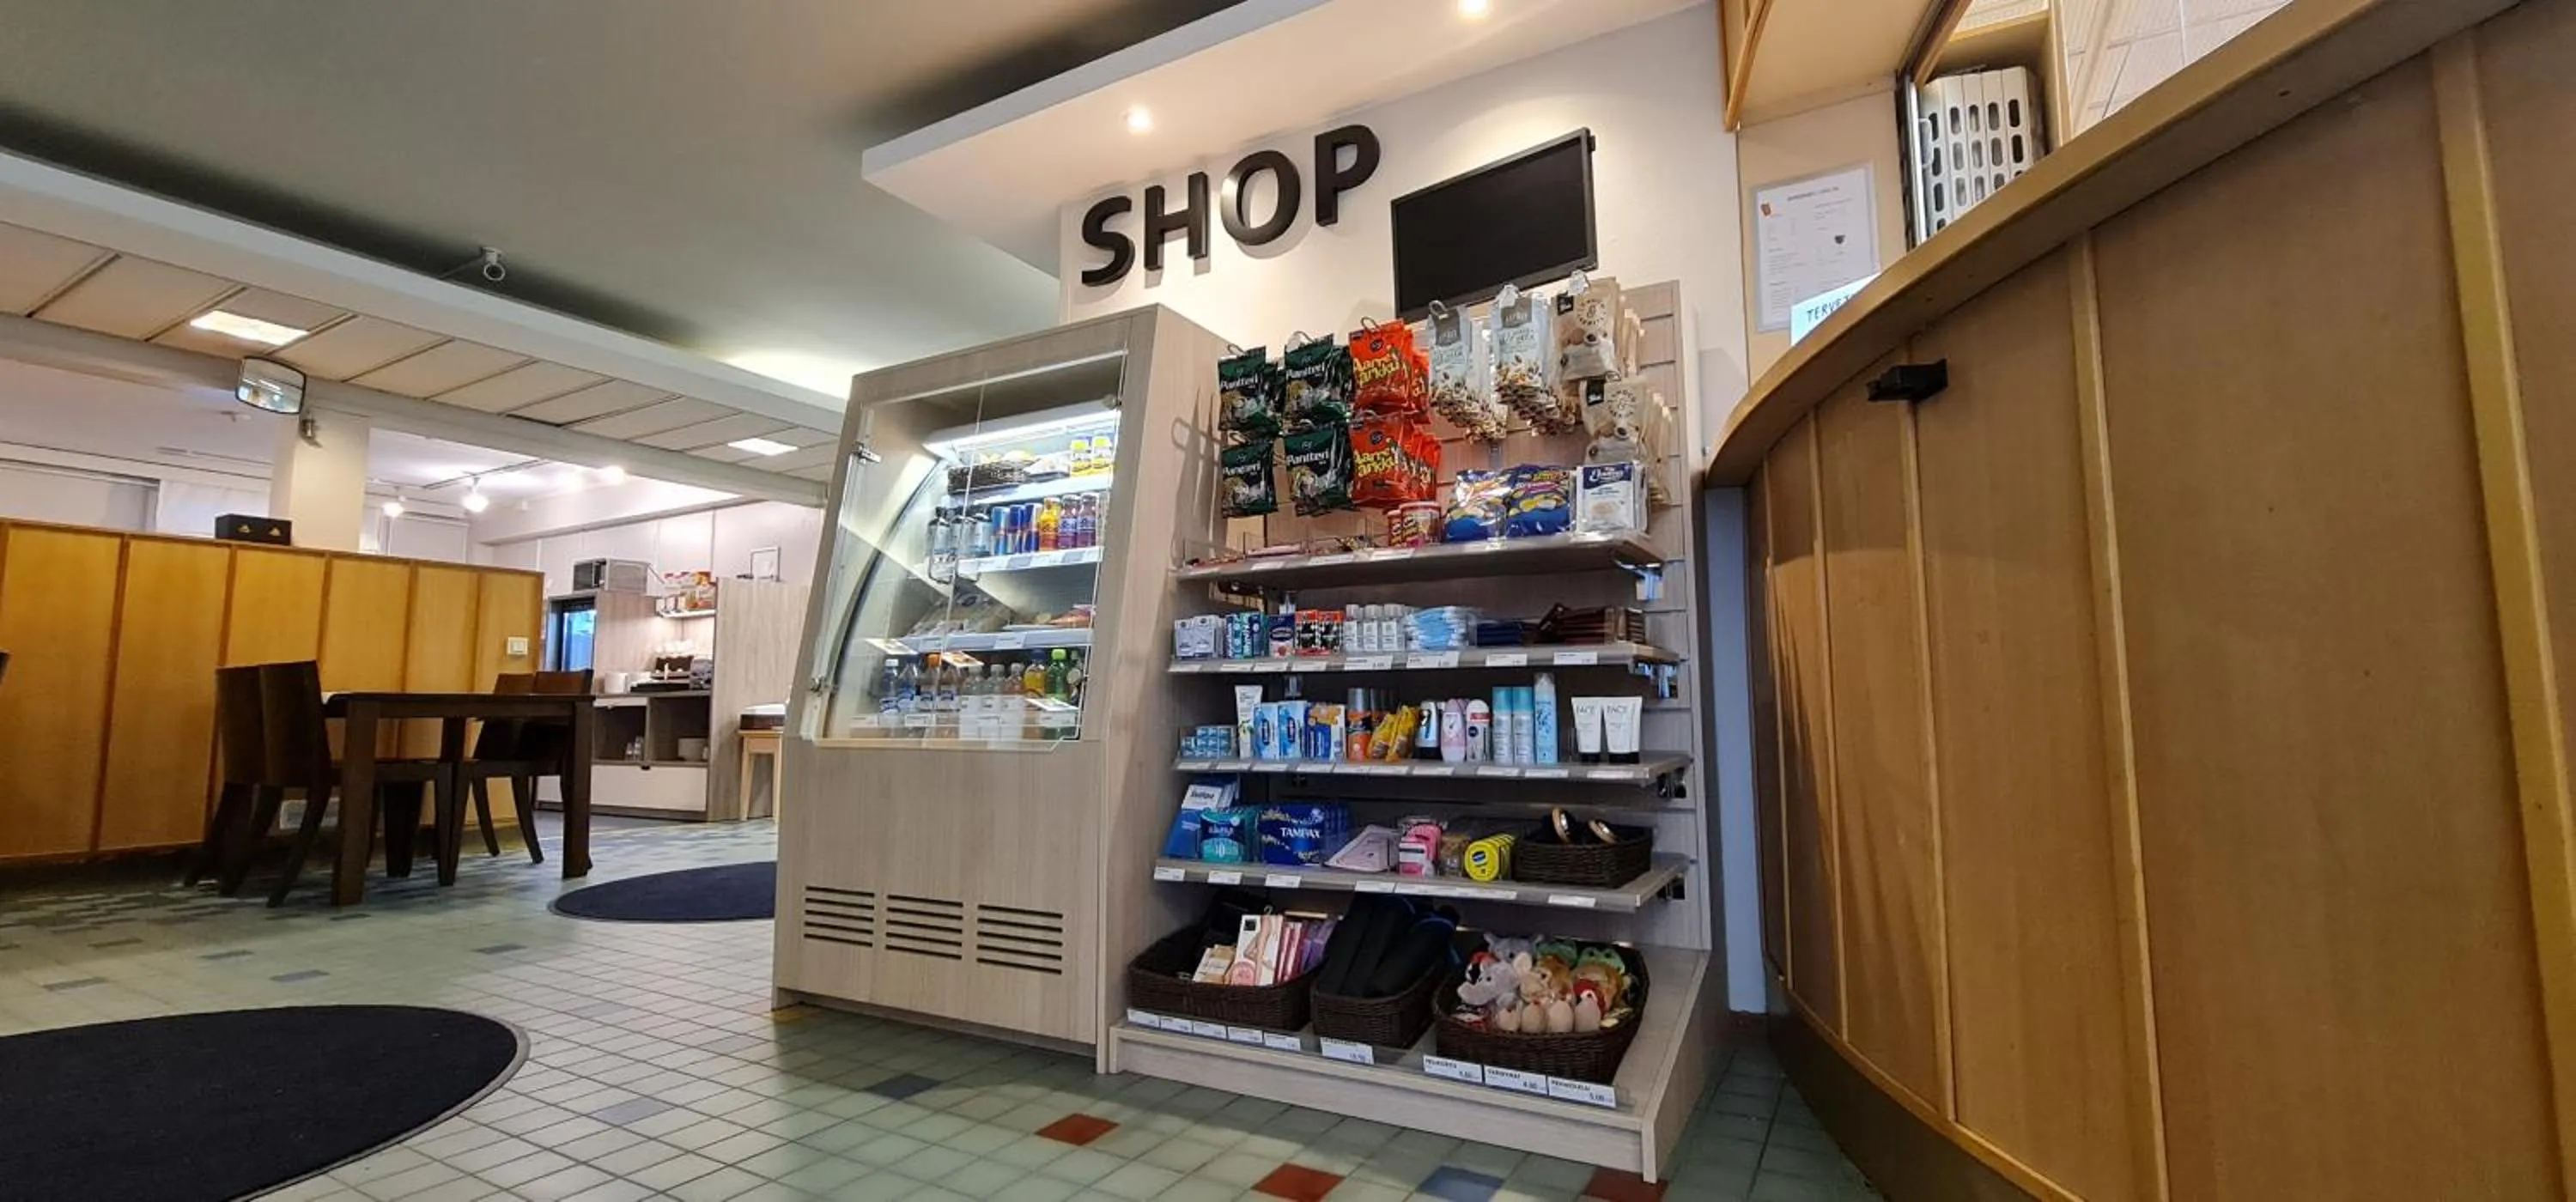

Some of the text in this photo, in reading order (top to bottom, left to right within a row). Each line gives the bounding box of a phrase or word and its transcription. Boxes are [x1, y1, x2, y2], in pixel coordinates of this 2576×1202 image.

[1081, 124, 1381, 286] SHOP
[1286, 447, 1329, 466] Pantteri
[1577, 705, 1595, 714] FACE
[1607, 704, 1627, 714] FACE
[1279, 827, 1321, 839] TAMPAX
